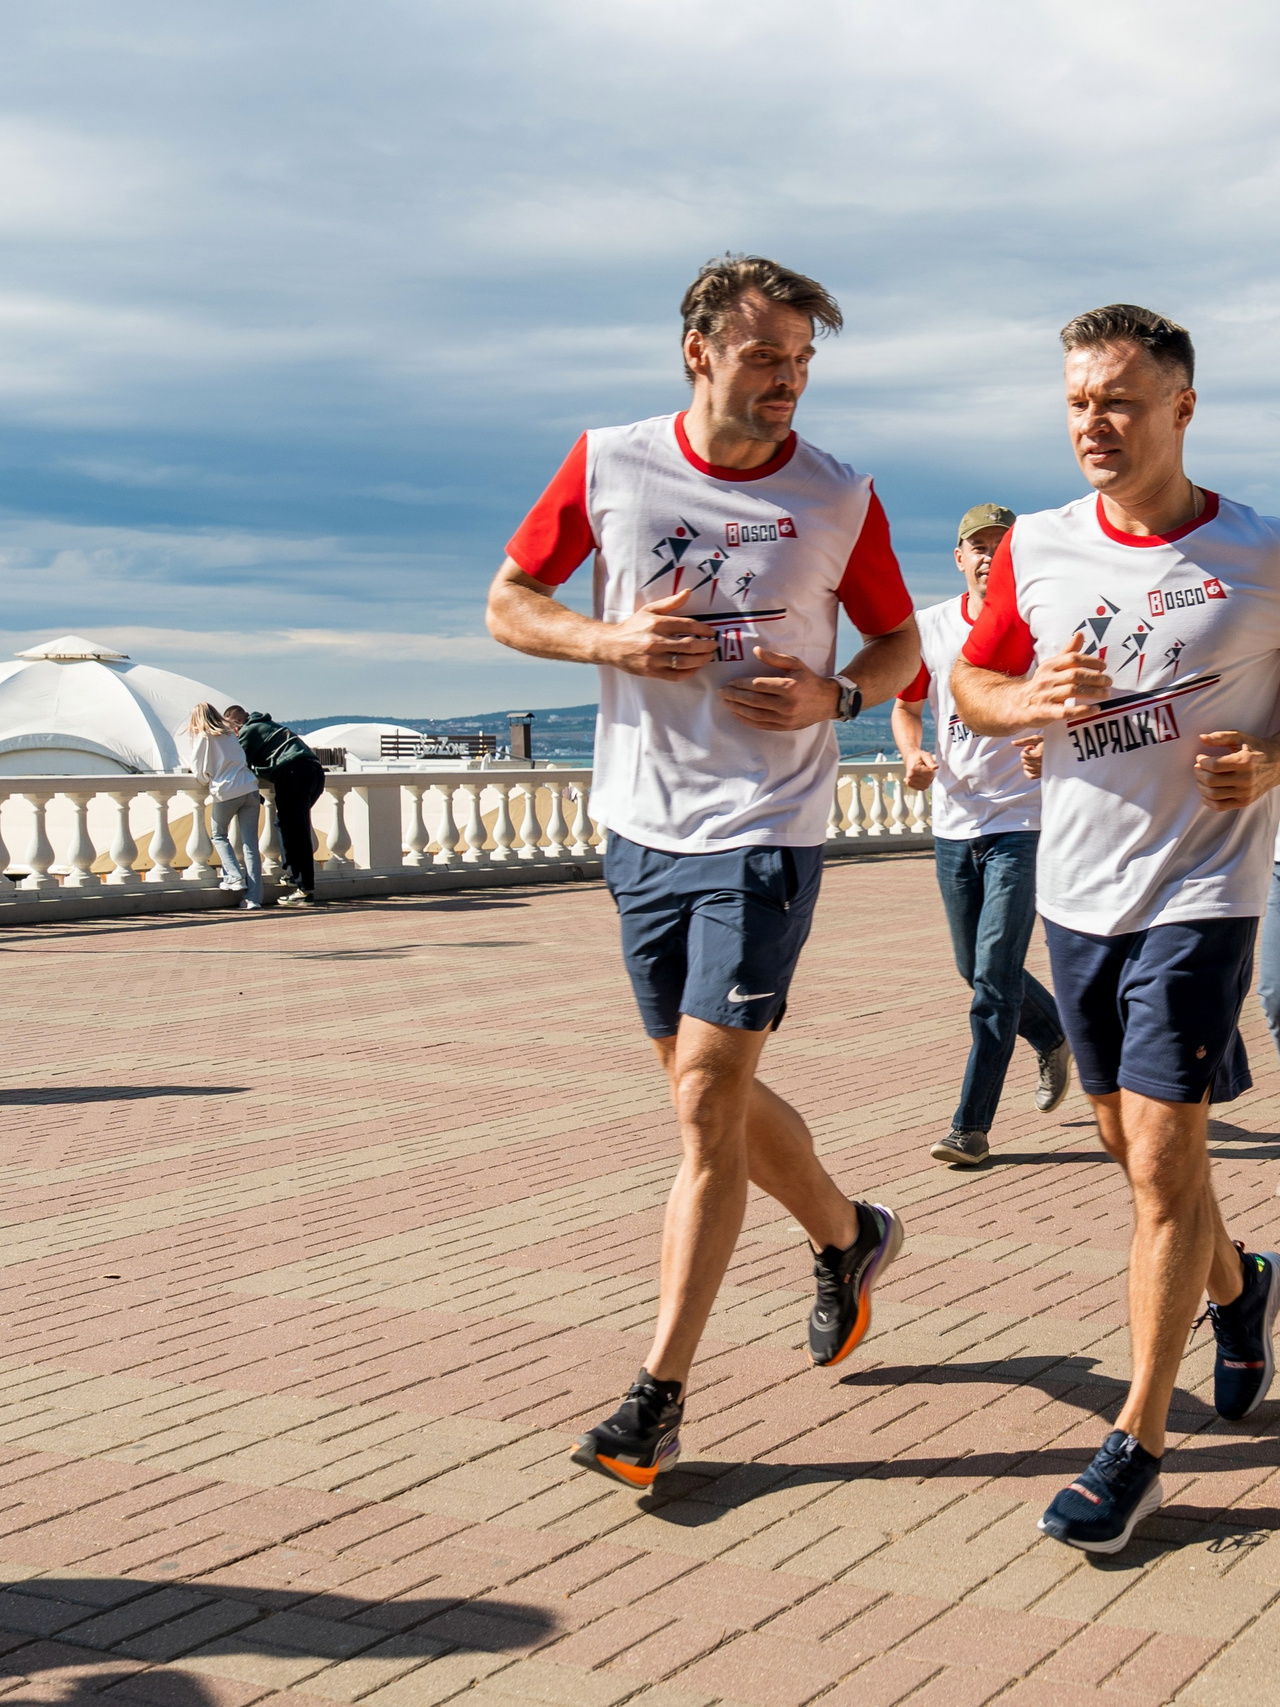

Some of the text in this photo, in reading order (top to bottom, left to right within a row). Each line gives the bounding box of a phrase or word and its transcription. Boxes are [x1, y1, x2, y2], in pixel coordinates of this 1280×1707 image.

[725, 522, 778, 547] BOSCO
[1147, 587, 1206, 617] BOSCO
[1068, 703, 1180, 762] ЗАРЯДКА
